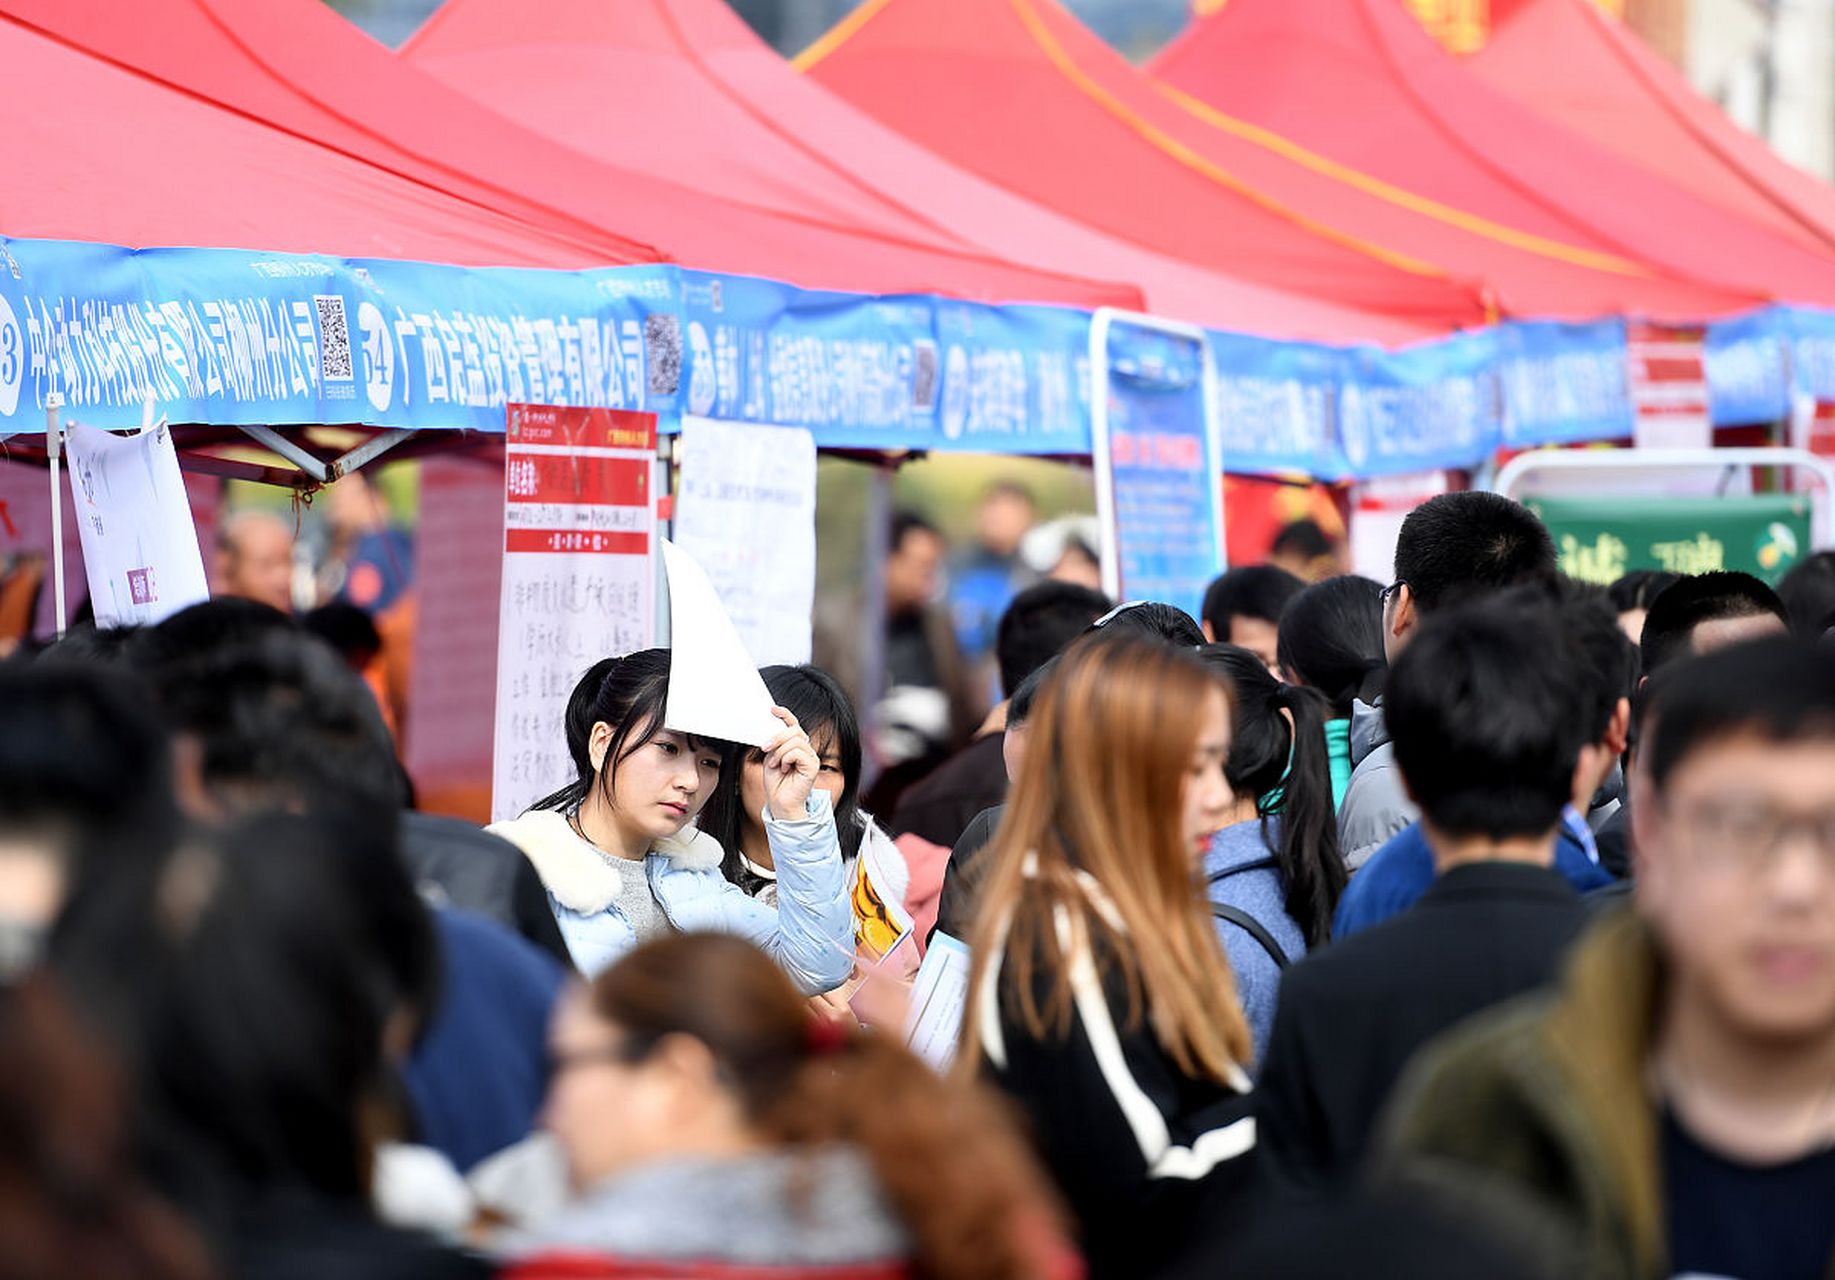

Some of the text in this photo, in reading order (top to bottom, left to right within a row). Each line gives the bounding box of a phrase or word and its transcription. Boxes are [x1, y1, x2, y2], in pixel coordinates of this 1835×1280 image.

[24, 294, 324, 410] 中企动力科技股份有限公司柳州分公司
